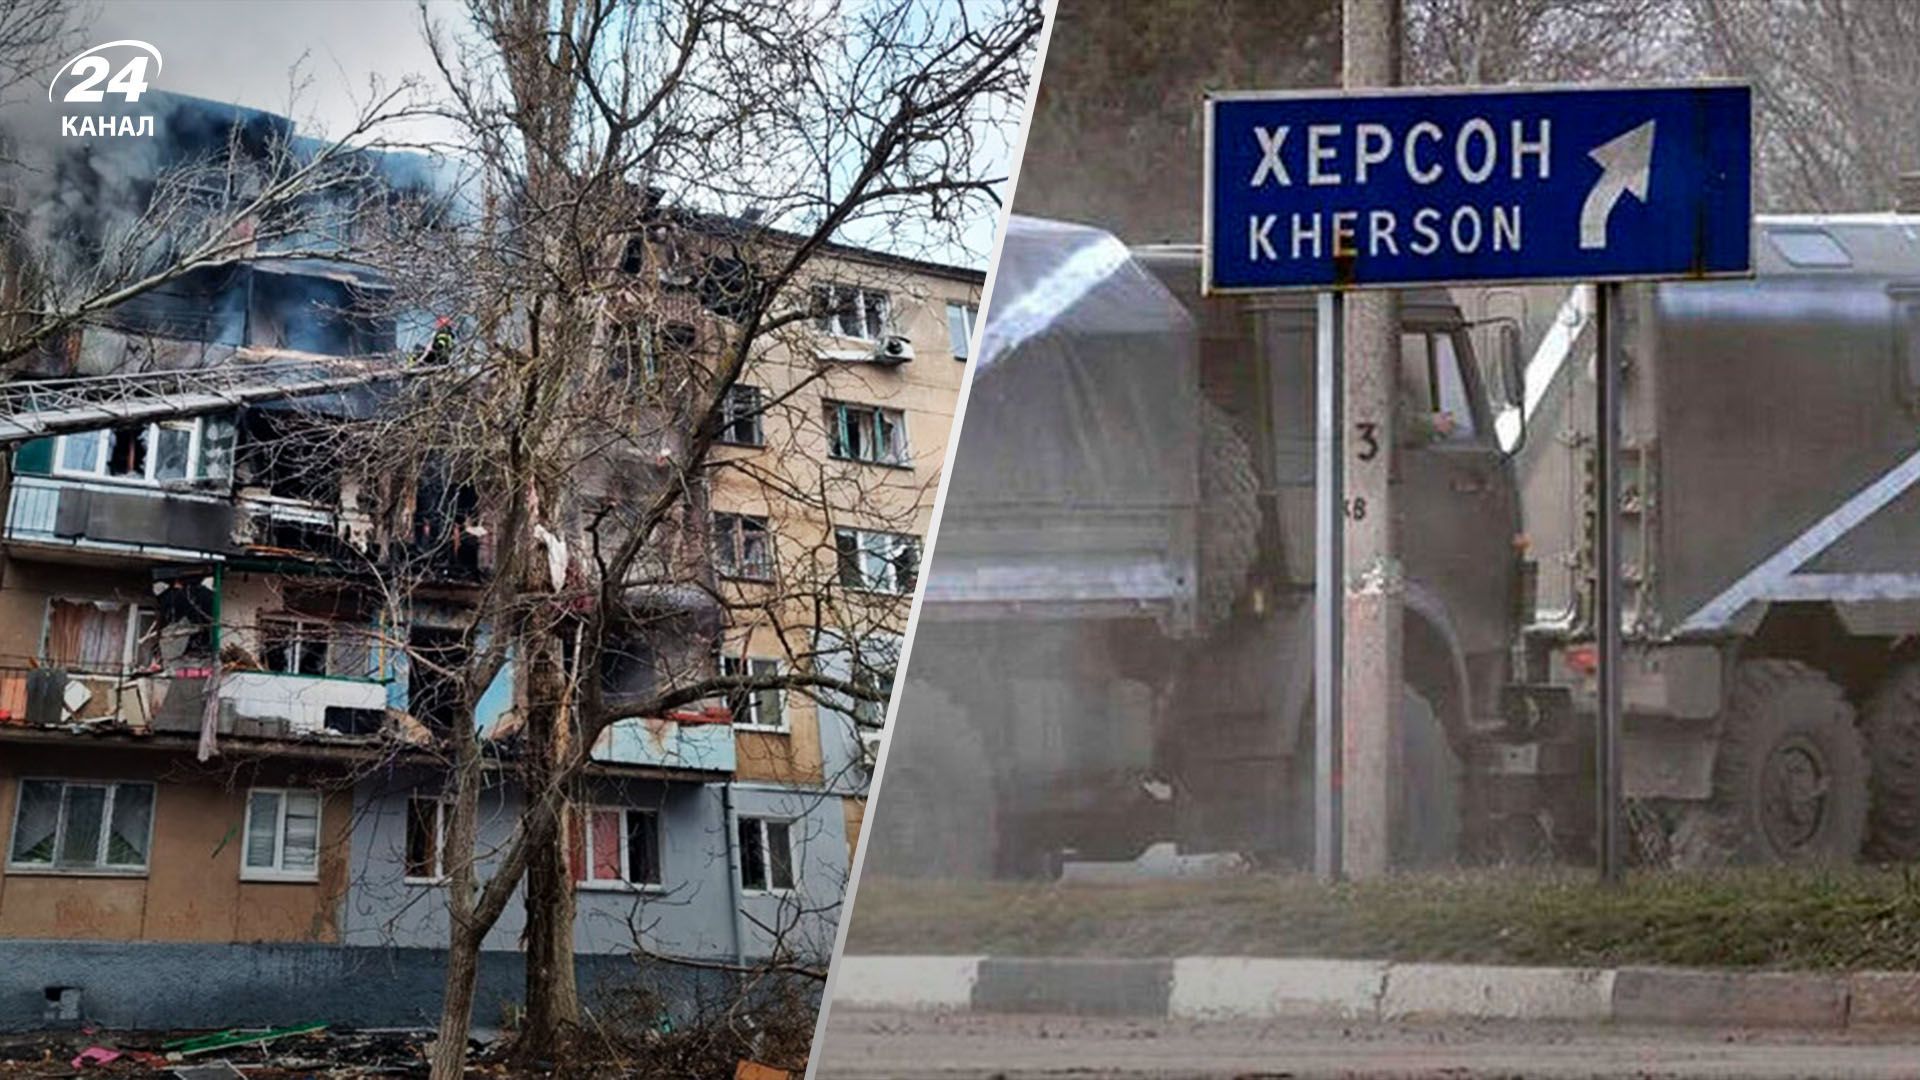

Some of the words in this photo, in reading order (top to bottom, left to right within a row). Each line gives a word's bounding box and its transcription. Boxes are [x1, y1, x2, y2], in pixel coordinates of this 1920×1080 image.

[1250, 117, 1551, 187] ХЕРСОН
[1249, 204, 1521, 261] KHERSON
[1355, 422, 1379, 462] 3
